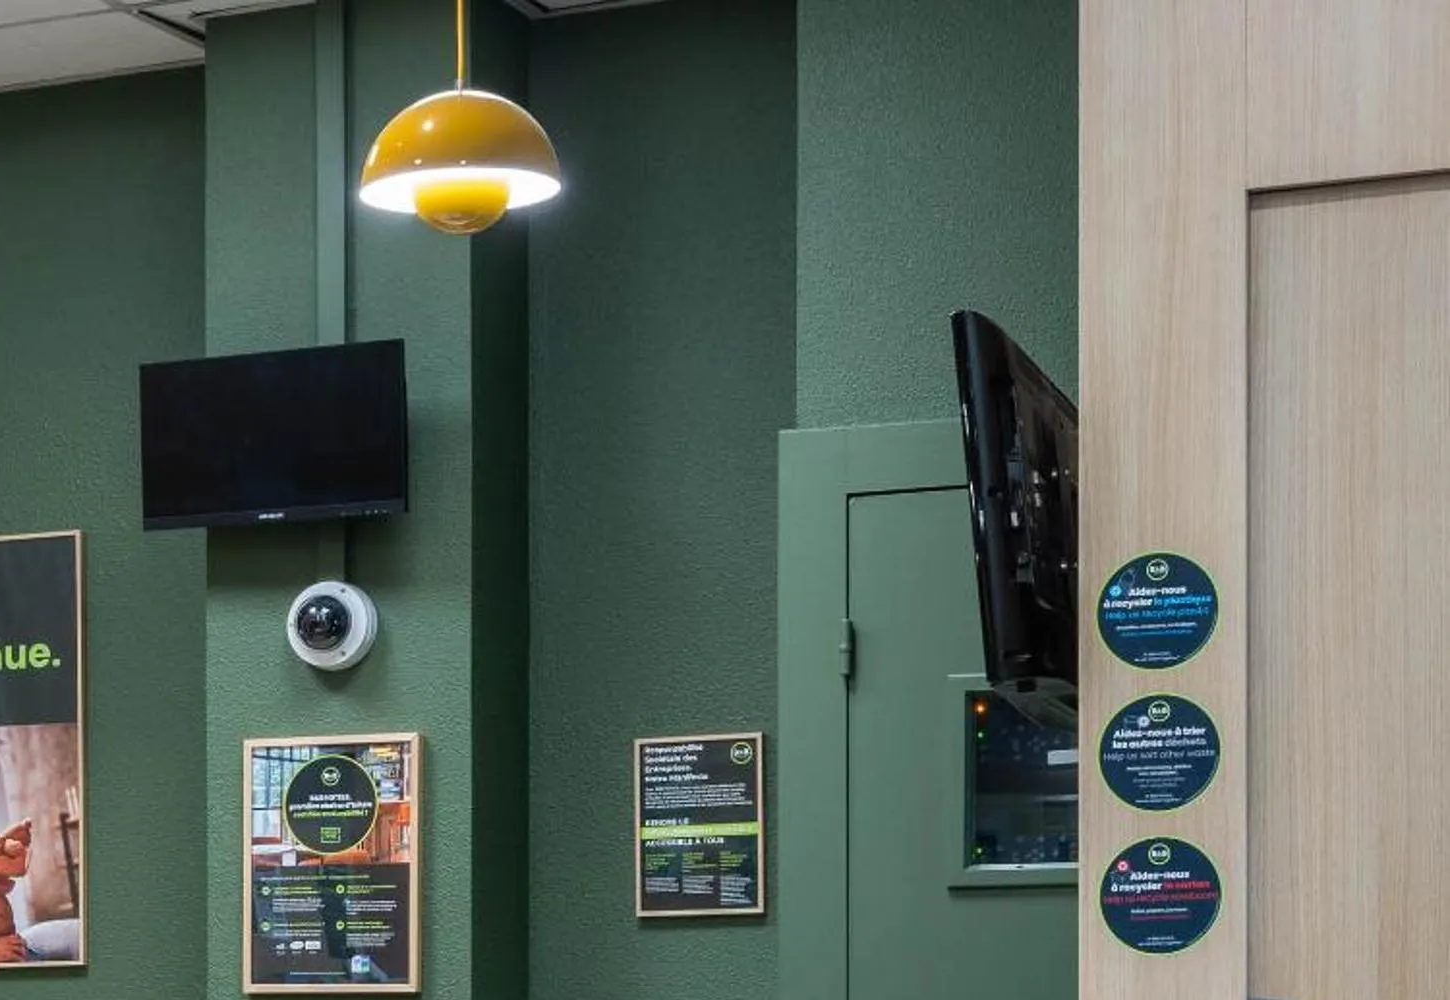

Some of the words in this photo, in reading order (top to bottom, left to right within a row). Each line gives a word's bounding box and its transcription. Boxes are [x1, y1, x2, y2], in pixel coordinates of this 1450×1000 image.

[1113, 728, 1173, 739] Aidez-nous
[1183, 725, 1206, 736] trier
[1130, 870, 1190, 881] Aidez-nous
[1119, 881, 1163, 894] recycler
